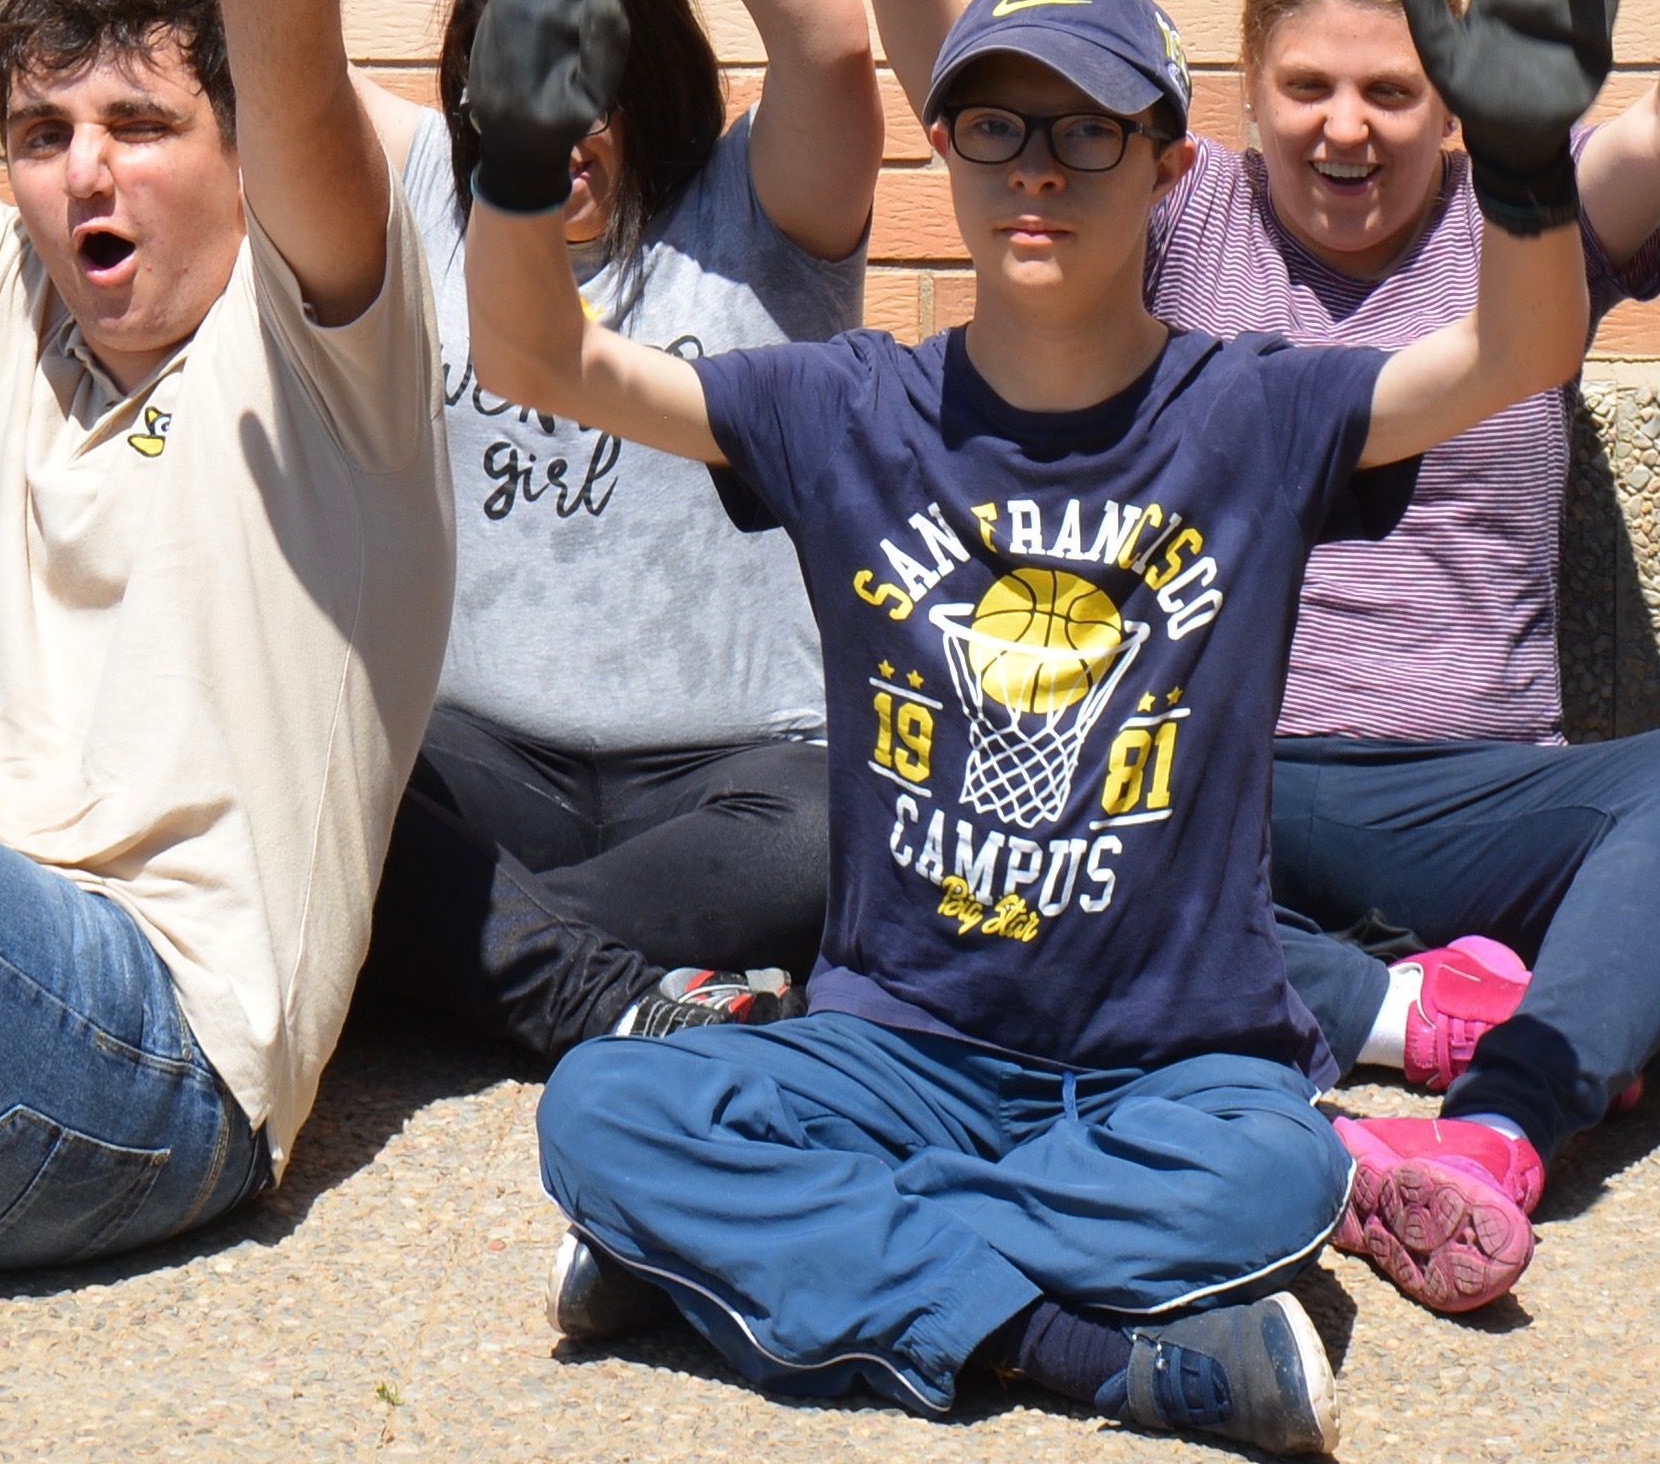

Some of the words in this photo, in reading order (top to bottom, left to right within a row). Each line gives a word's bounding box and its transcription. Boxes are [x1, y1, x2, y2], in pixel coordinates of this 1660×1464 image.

[483, 434, 622, 521] girl
[853, 502, 971, 621] SAN
[971, 498, 1223, 640] FRANCISCO
[873, 692, 934, 783] 19
[1101, 721, 1178, 816] 81
[889, 793, 1123, 917] CAMPUS
[937, 874, 983, 936] Big
[981, 893, 1040, 943] Star
